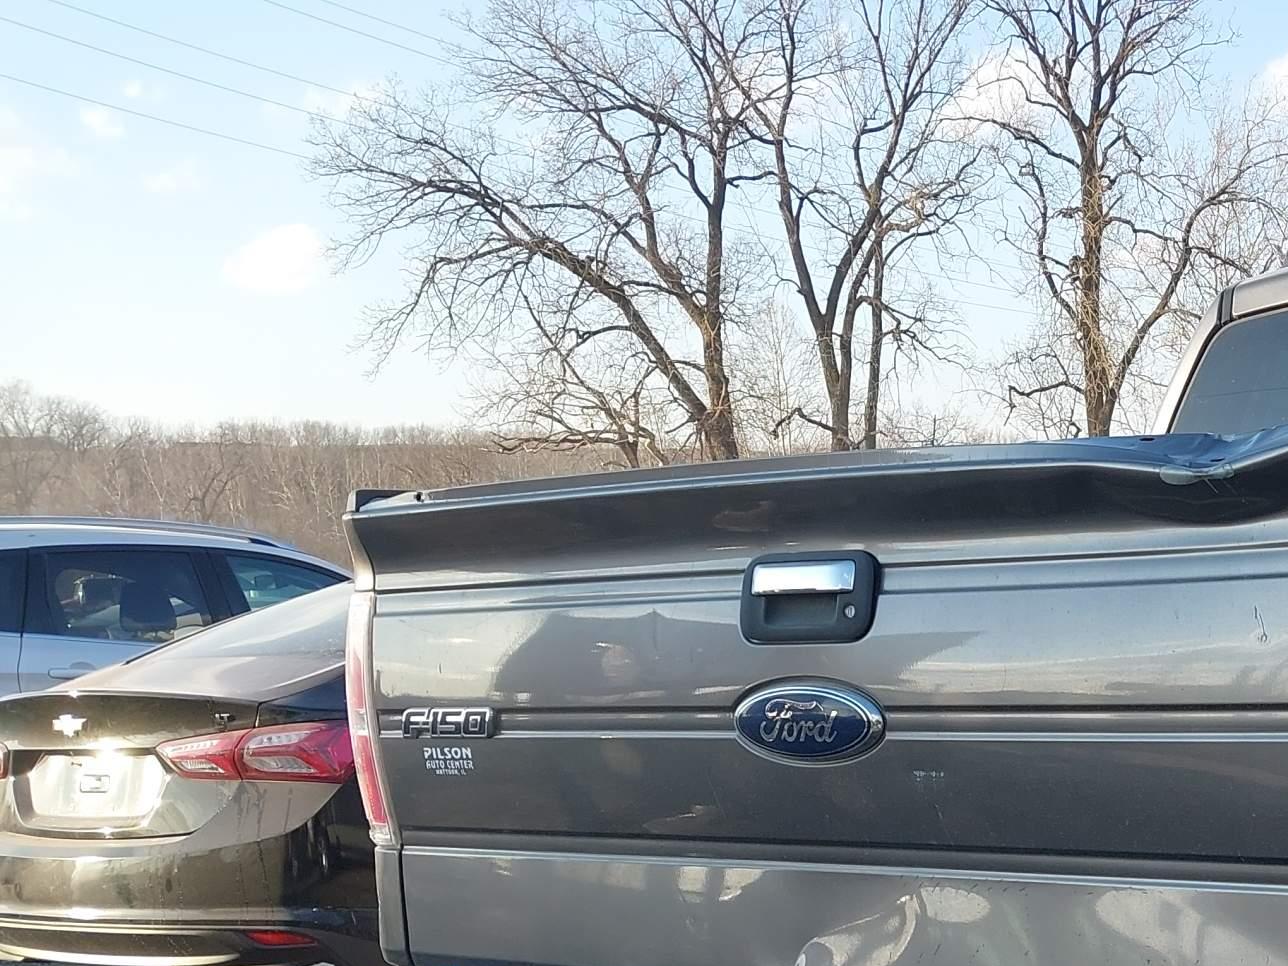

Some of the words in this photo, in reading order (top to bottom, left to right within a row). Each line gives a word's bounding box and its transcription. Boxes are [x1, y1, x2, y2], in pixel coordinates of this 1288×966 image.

[760, 698, 838, 742] Ford
[423, 747, 472, 759] PILSON
[426, 760, 445, 769] AUTO
[446, 760, 474, 769] CENTER
